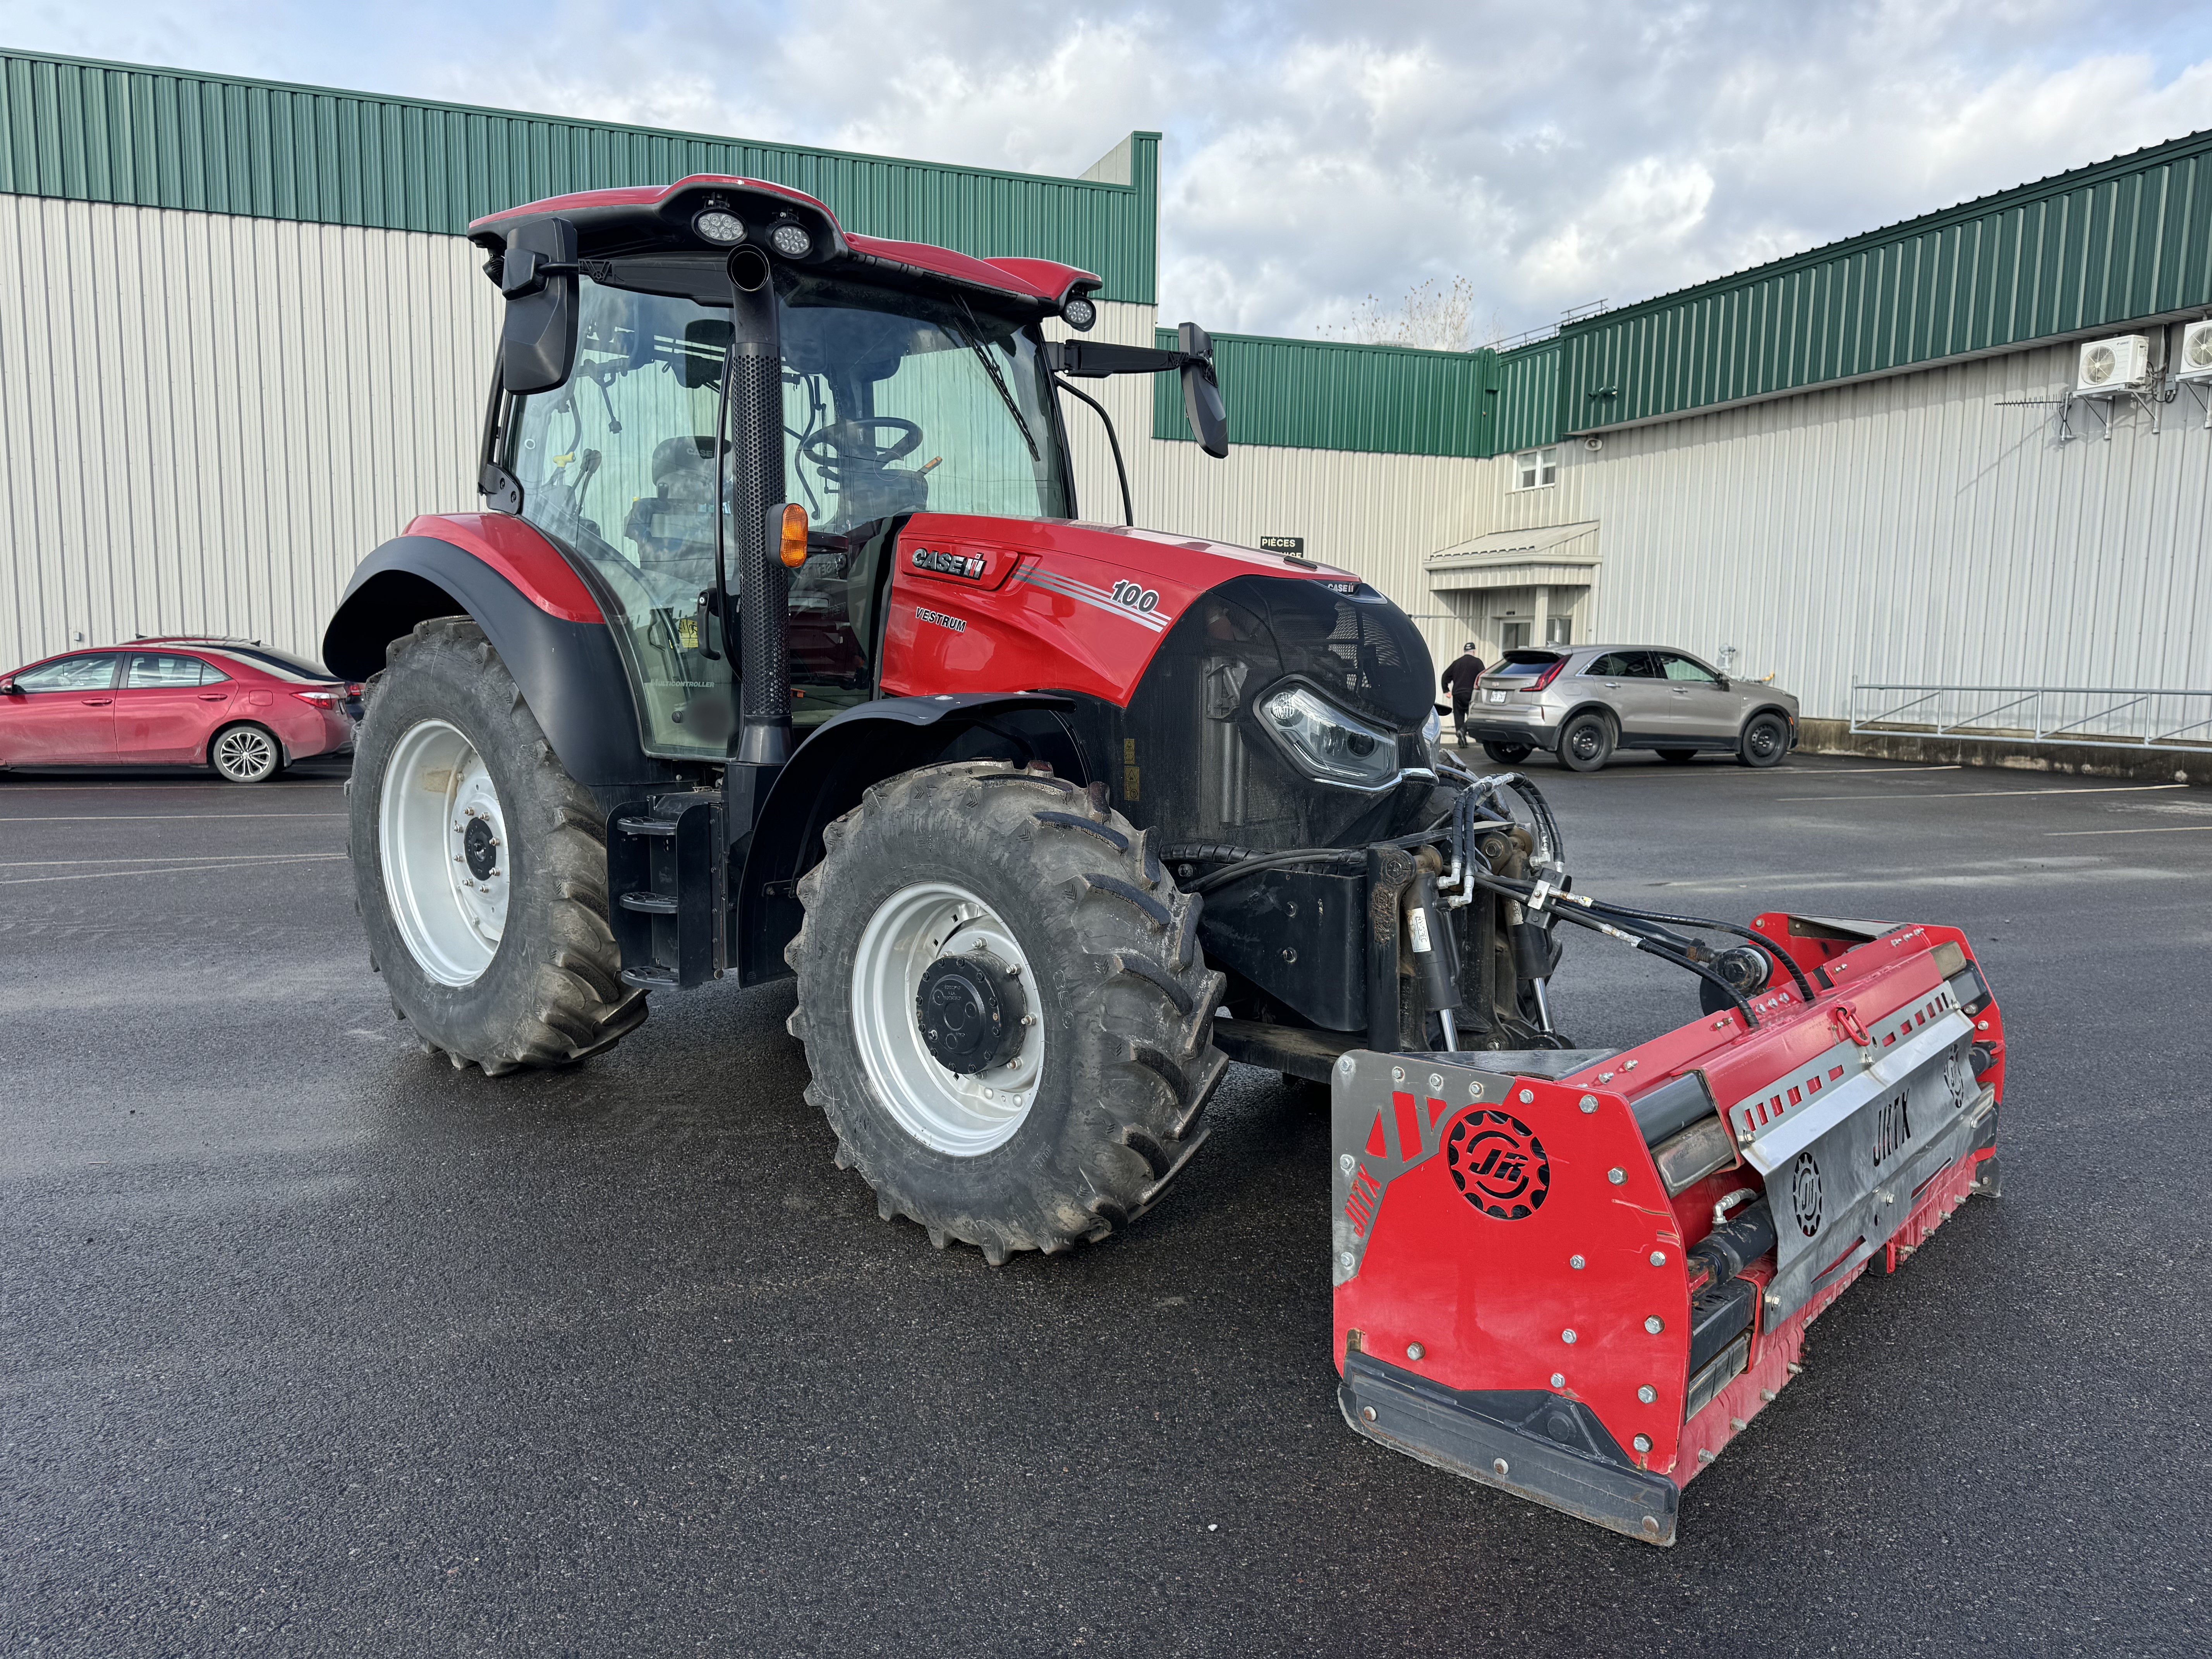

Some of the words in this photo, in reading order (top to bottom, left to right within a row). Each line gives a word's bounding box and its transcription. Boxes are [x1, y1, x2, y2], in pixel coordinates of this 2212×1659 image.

[687, 448, 713, 457] CASE
[1262, 537, 1296, 548] PIÈCES
[912, 547, 967, 575] CASE
[1112, 579, 1159, 614] 100
[1328, 583, 1348, 592] CASE
[915, 606, 967, 633] VESTRUM
[1415, 915, 1427, 943] HY-SPEC
[1468, 1148, 1529, 1183] JR
[1344, 1162, 1381, 1238] JRTX
